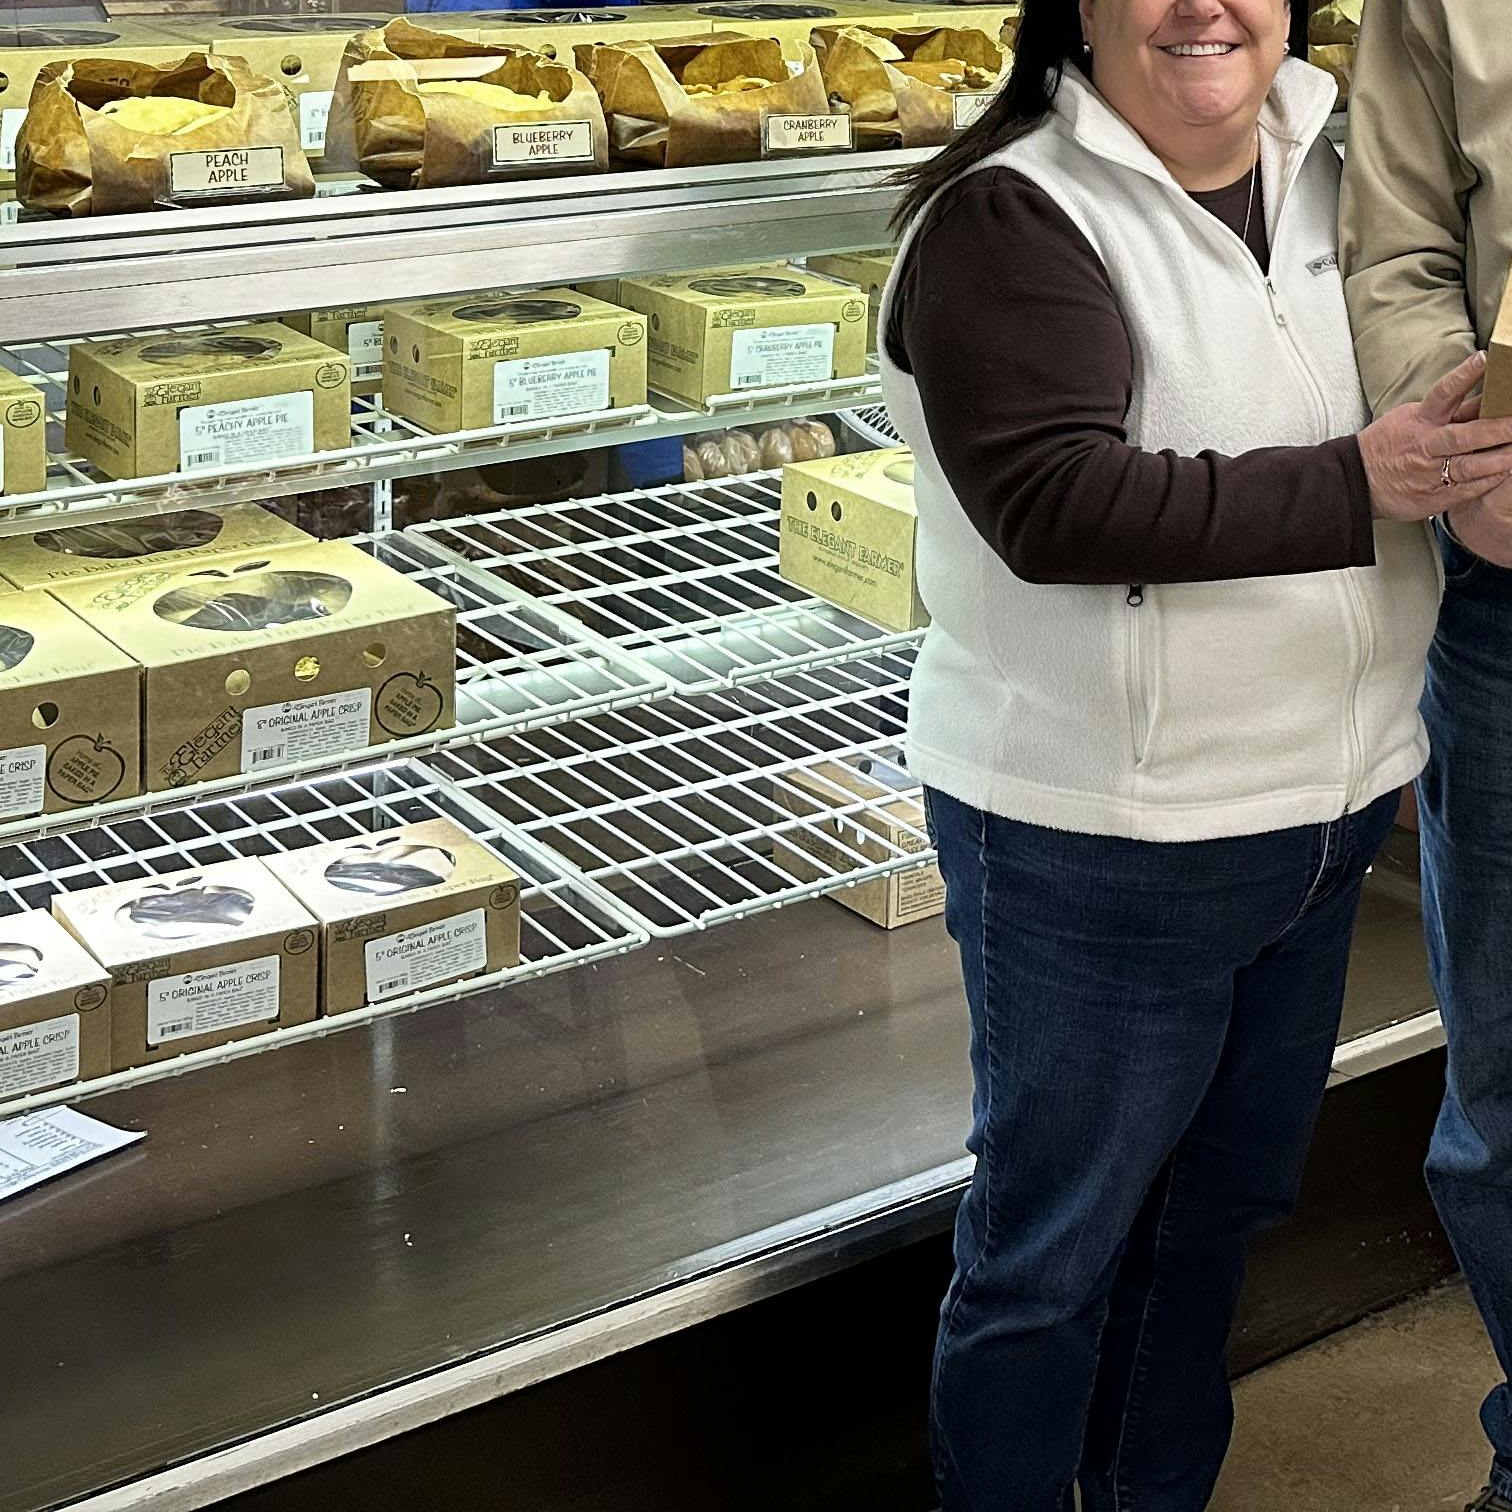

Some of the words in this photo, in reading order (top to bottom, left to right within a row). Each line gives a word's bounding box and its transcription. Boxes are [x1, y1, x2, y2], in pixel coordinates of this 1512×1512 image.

[783, 118, 838, 132] CRANBERRY
[512, 129, 574, 145] BLUEBERRY
[797, 129, 825, 144] APPLE
[528, 143, 560, 157] APPLE
[205, 152, 249, 169] PEACH
[207, 166, 248, 184] APPLE
[518, 372, 562, 387] BLUEBERRY
[564, 369, 585, 380] APPLE
[586, 368, 597, 377] PIE
[207, 421, 243, 433] PEACHY
[246, 417, 273, 430] APPLE
[275, 413, 288, 424] PIE
[787, 515, 808, 539] THE
[810, 524, 857, 559] ELEGANT
[48, 569, 75, 579] Pie
[82, 558, 143, 574] Baked
[147, 555, 162, 564] in
[185, 545, 233, 559] Paper
[268, 712, 309, 728] ORIGINAL
[311, 706, 335, 721] APPLE
[338, 702, 363, 716] CRISP
[170, 705, 241, 767] Elegant
[8, 759, 36, 774] CRISP
[386, 939, 426, 958] ORIGINAL
[427, 931, 452, 946] APPLE
[453, 922, 478, 937] CRISP
[171, 983, 213, 1000] ORIGINAL
[217, 977, 243, 990] APPLE
[245, 969, 272, 984] CRISP
[11, 1037, 41, 1053] APPLE
[42, 1029, 71, 1045] CRISP
